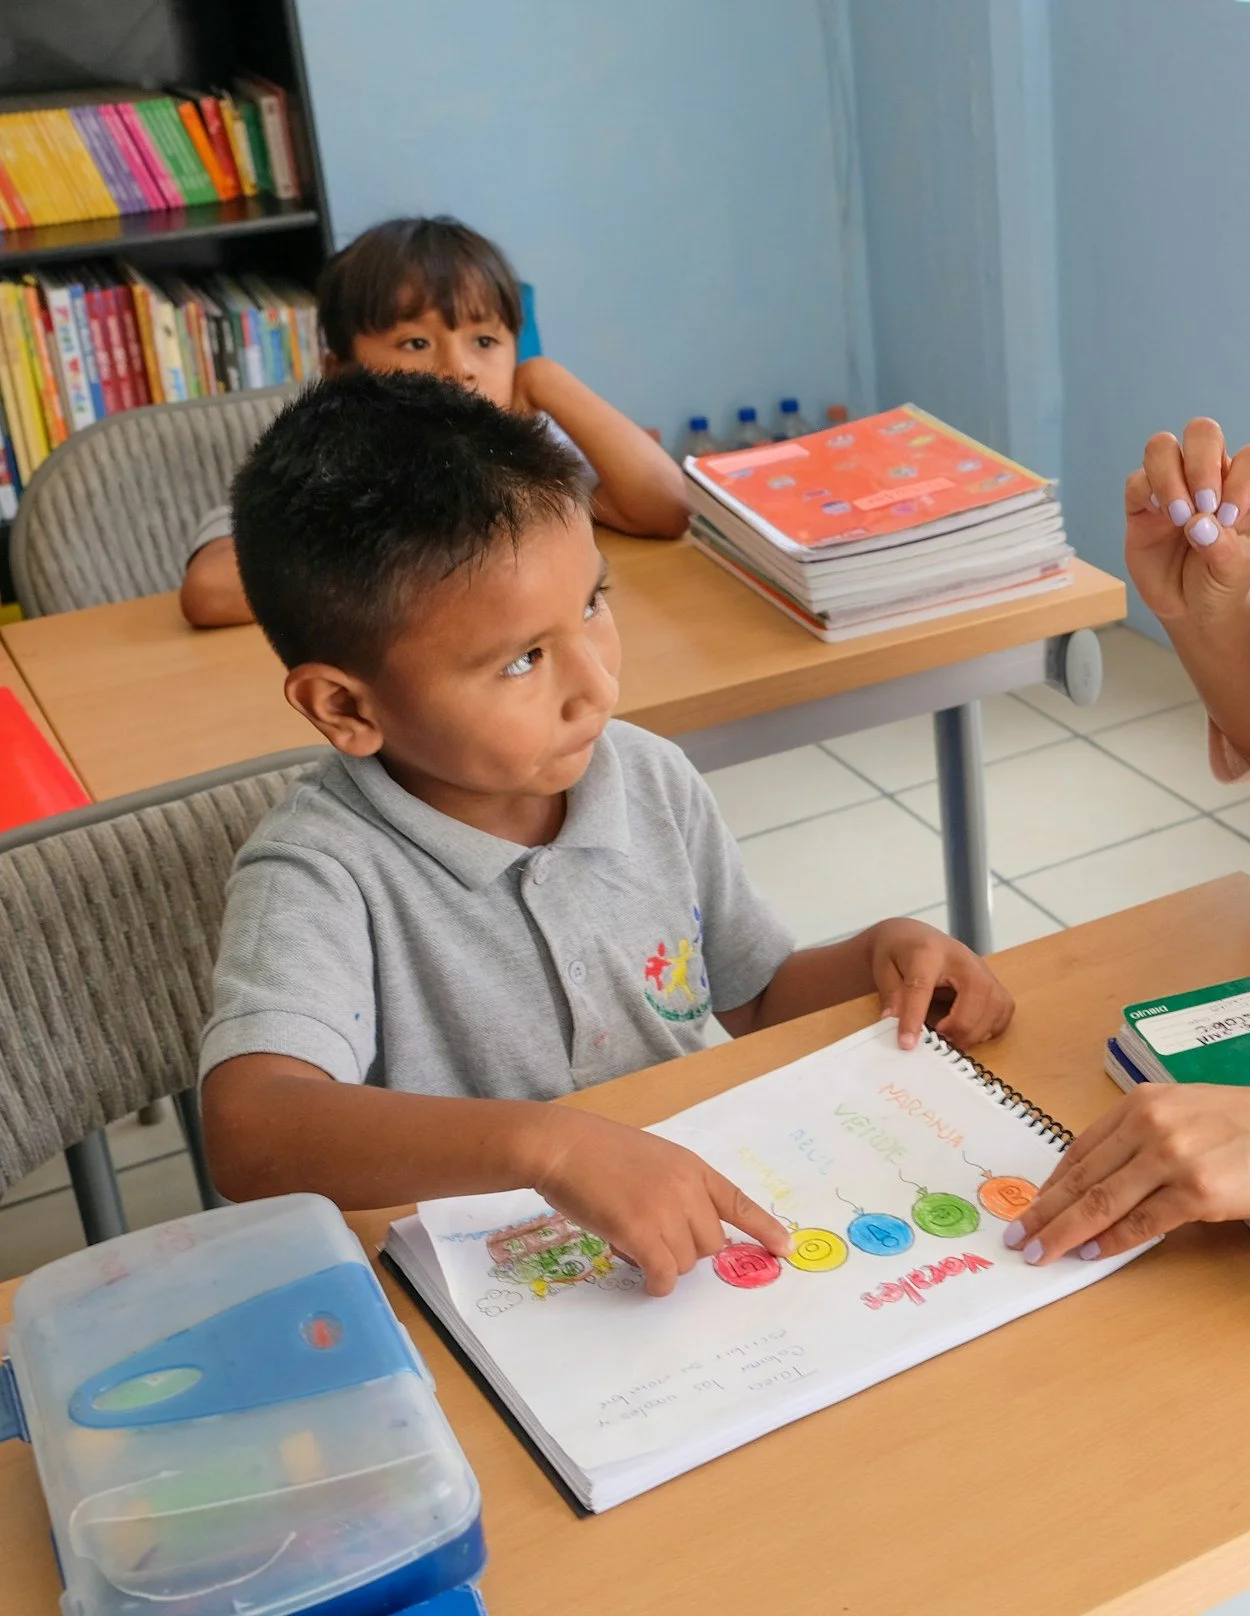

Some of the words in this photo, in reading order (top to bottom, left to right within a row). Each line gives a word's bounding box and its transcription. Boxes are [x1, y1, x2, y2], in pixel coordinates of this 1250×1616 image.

[1129, 1004, 1169, 1020] DIBUJO
[877, 1083, 965, 1148] NARANJA
[788, 1128, 834, 1176] AZUL
[860, 1252, 994, 1311] Vocales
